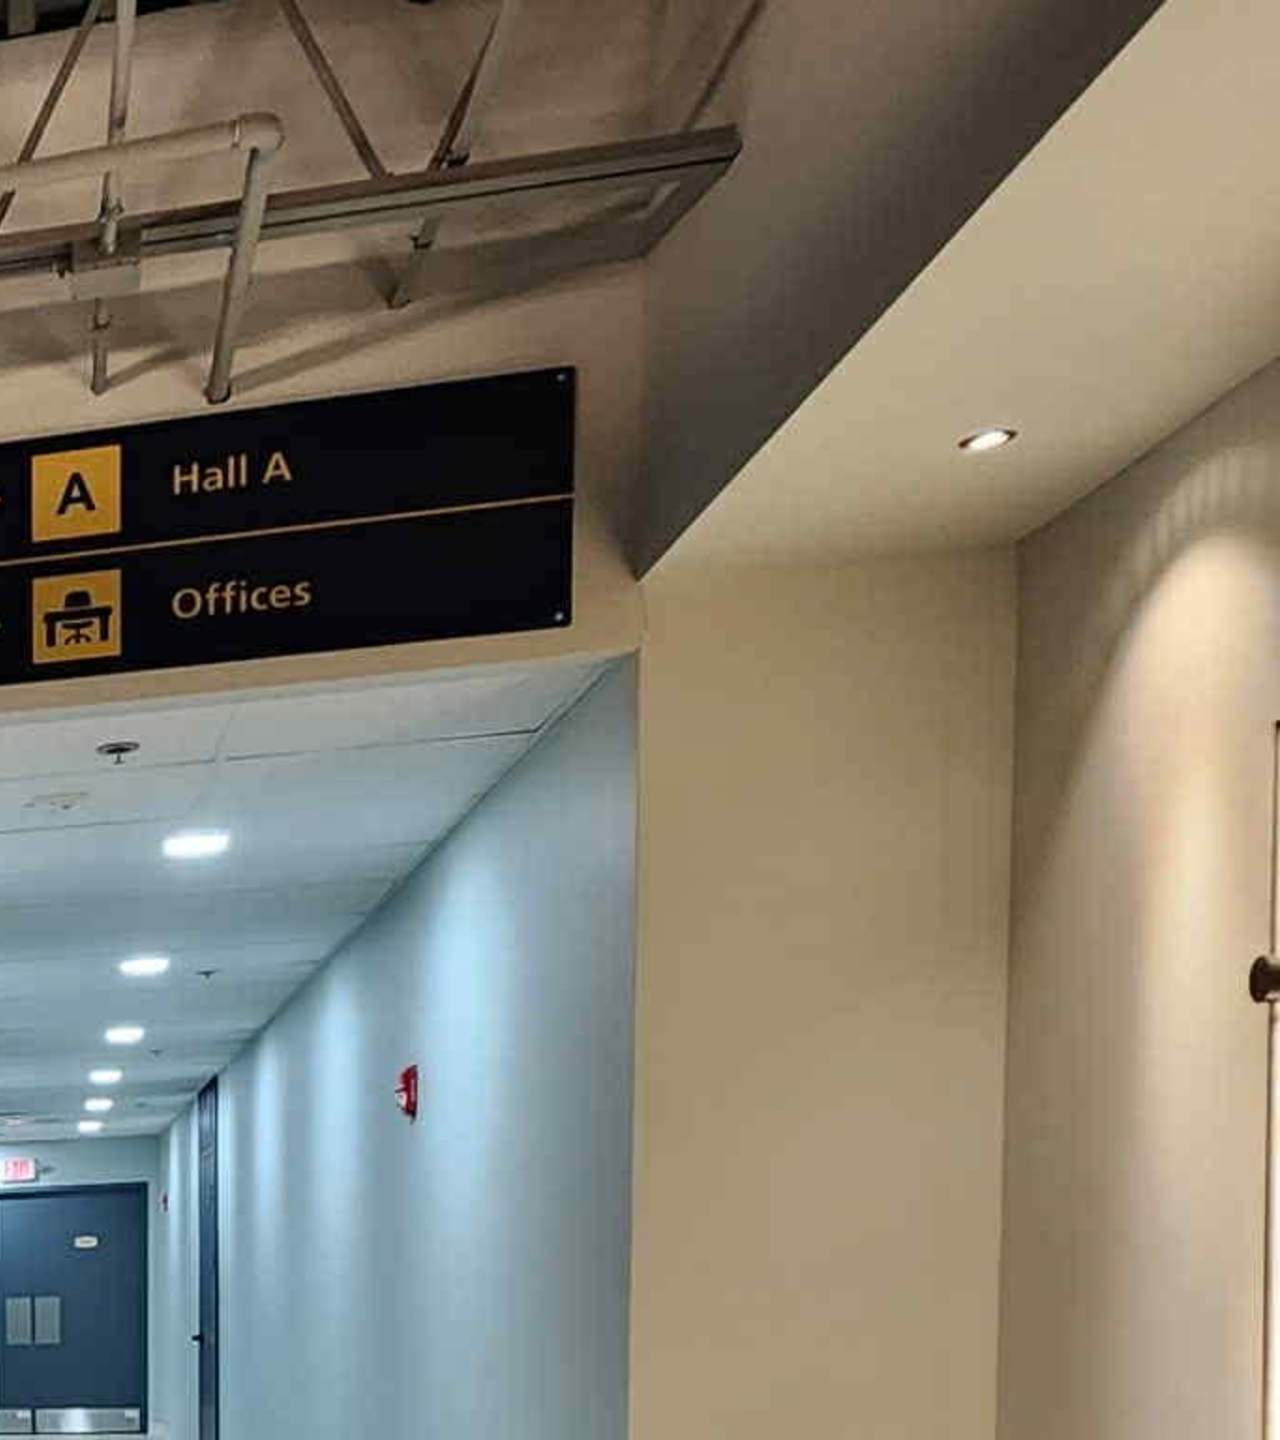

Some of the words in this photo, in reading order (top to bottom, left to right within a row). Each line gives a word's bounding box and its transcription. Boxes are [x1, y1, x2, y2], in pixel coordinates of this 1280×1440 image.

[55, 471, 97, 516] A
[172, 453, 248, 495] Hall
[262, 451, 293, 484] A
[171, 580, 312, 618] Offices
